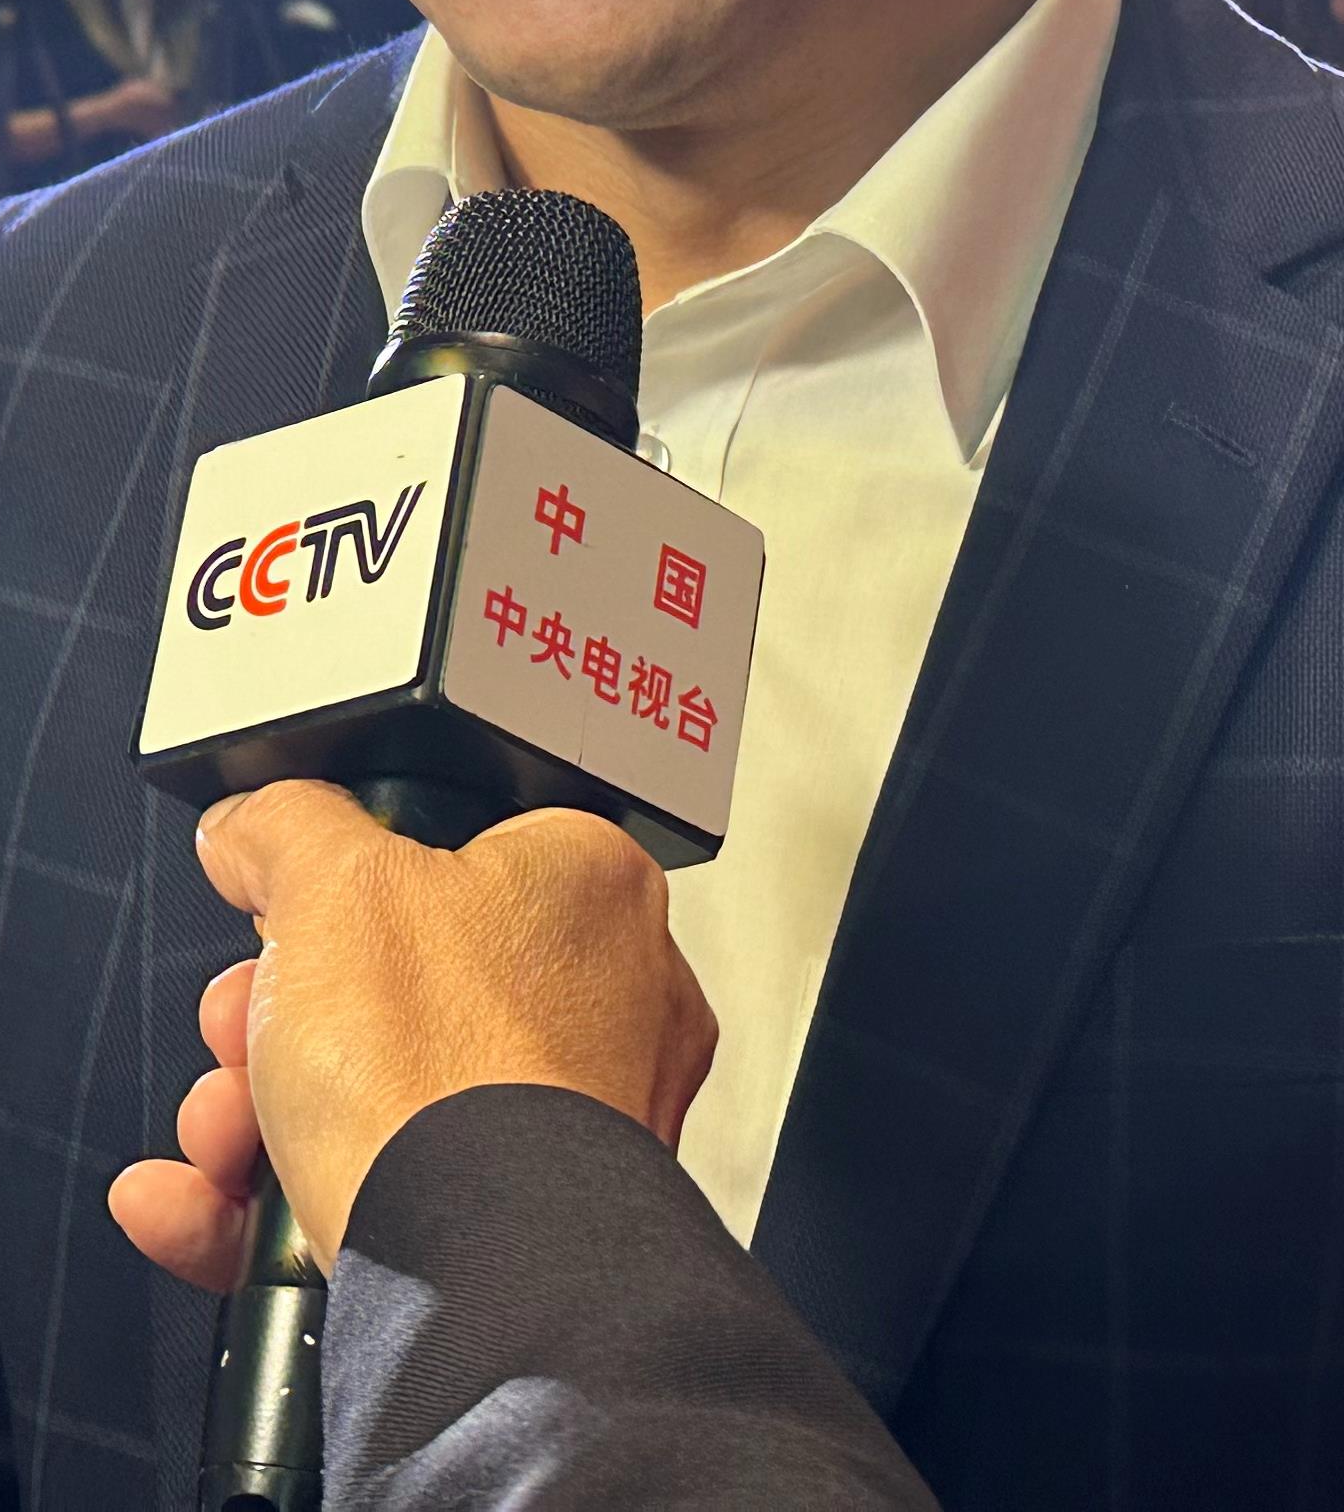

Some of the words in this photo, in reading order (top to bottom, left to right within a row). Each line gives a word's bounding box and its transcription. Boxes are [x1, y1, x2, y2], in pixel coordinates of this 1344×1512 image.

[186, 480, 428, 631] CCTV
[483, 585, 719, 753] 中央电视台
